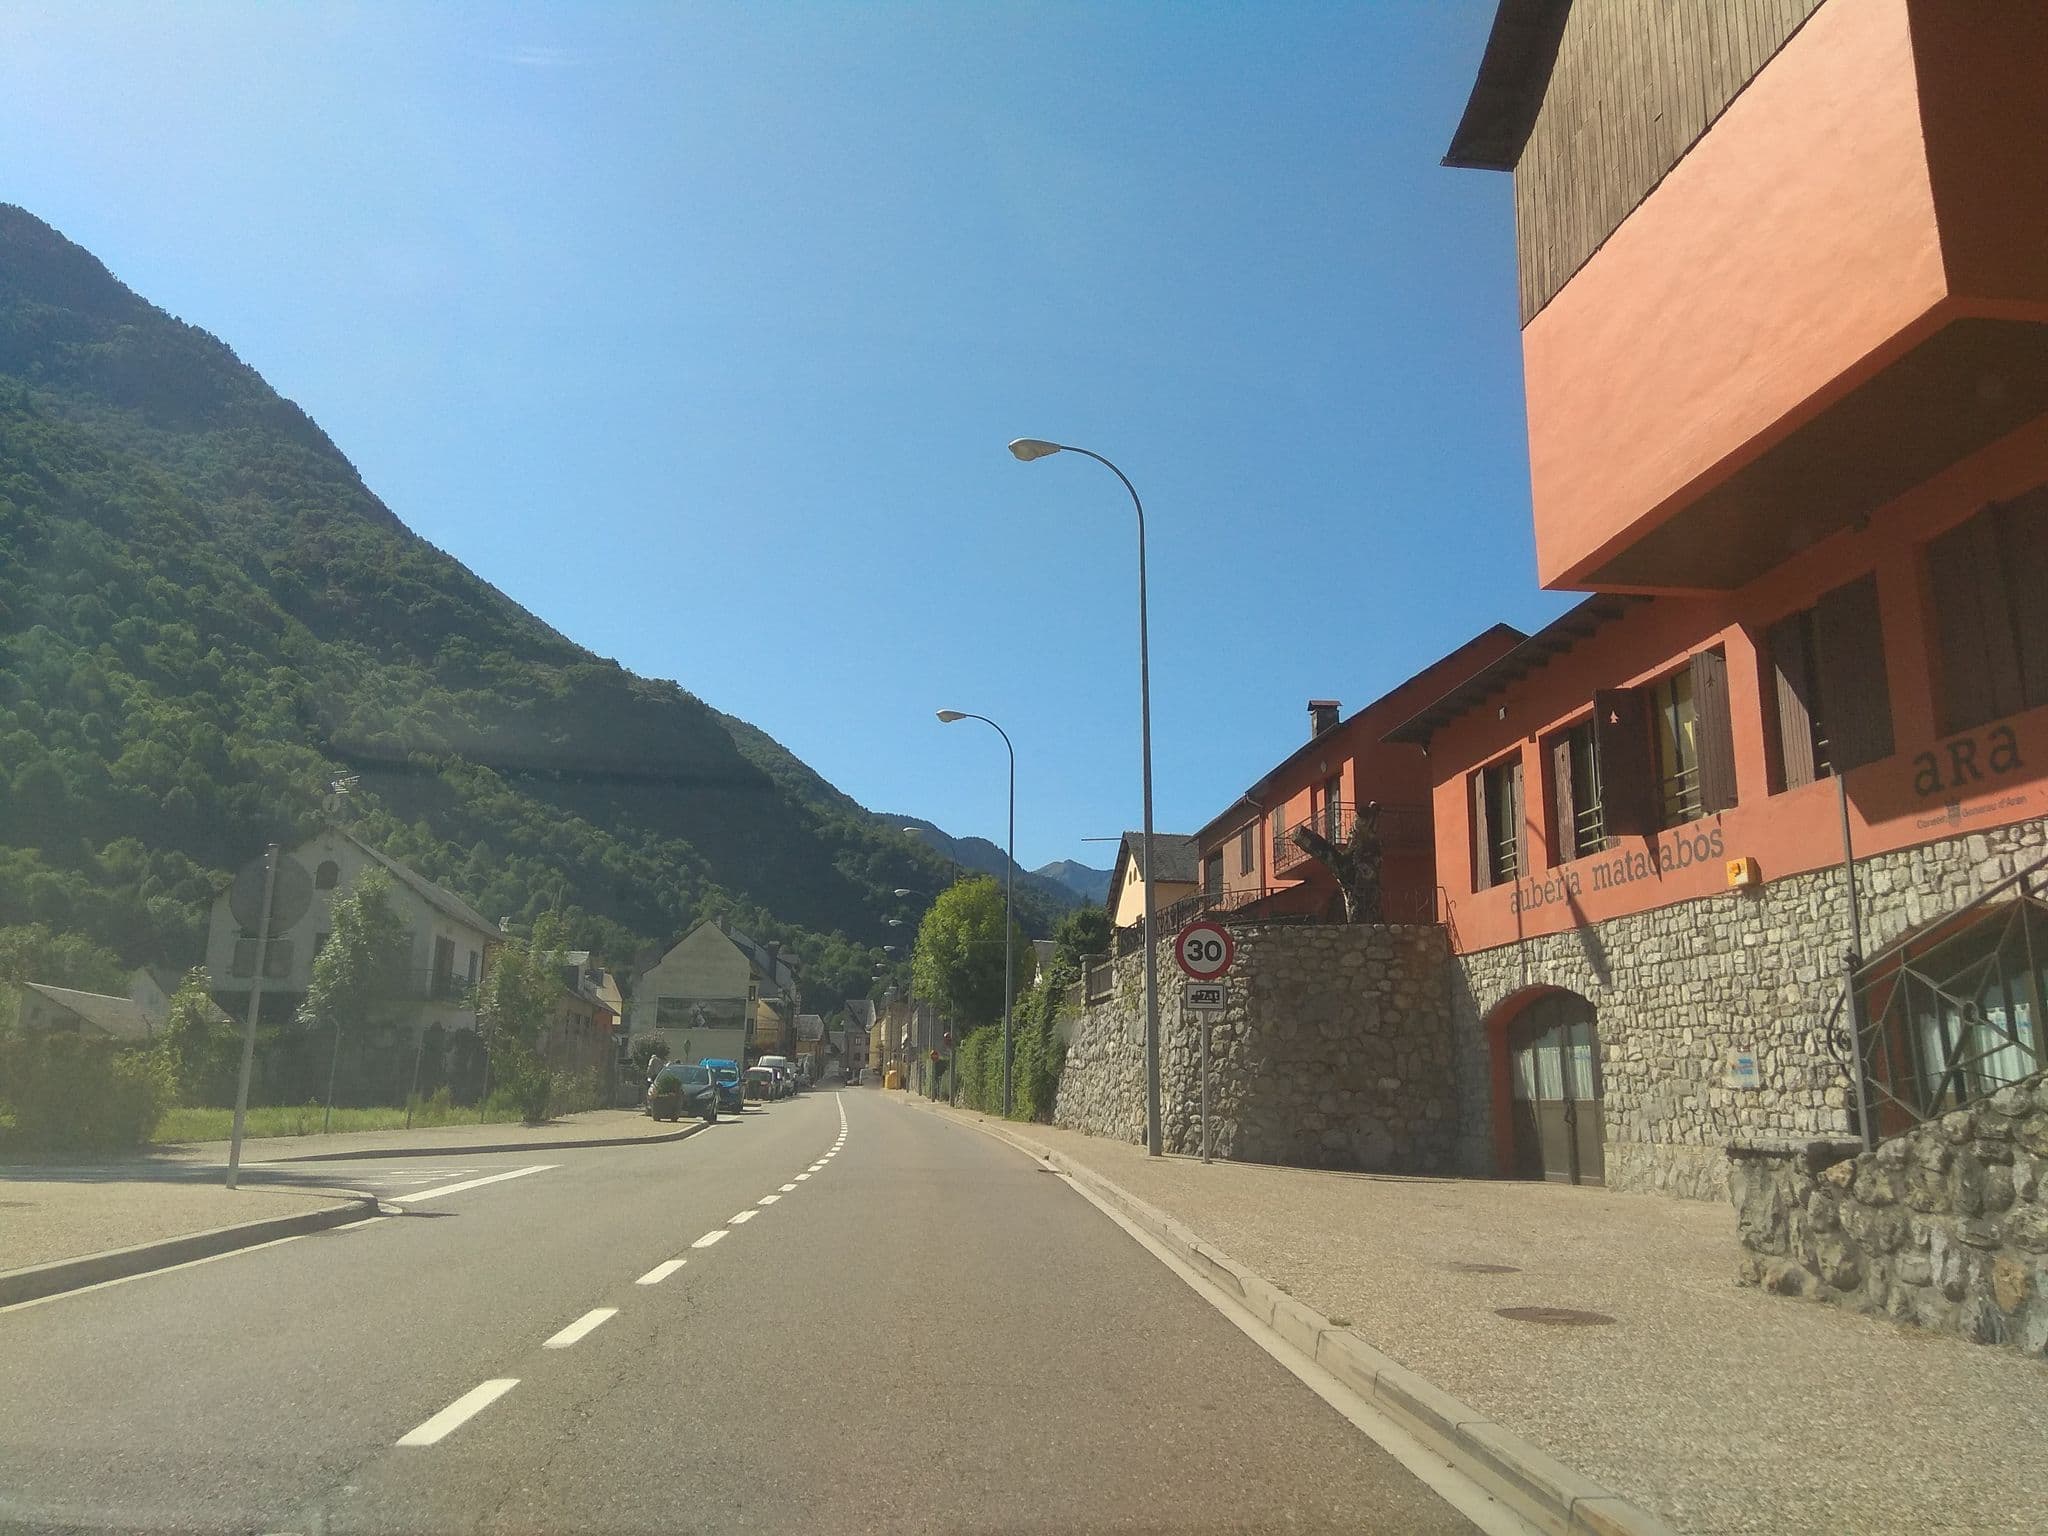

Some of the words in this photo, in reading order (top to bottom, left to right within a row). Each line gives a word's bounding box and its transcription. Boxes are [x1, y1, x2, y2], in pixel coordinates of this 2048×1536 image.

[1912, 725, 2024, 797] aRa
[1510, 866, 1583, 915] aubèrja
[1187, 940, 1222, 961] 30
